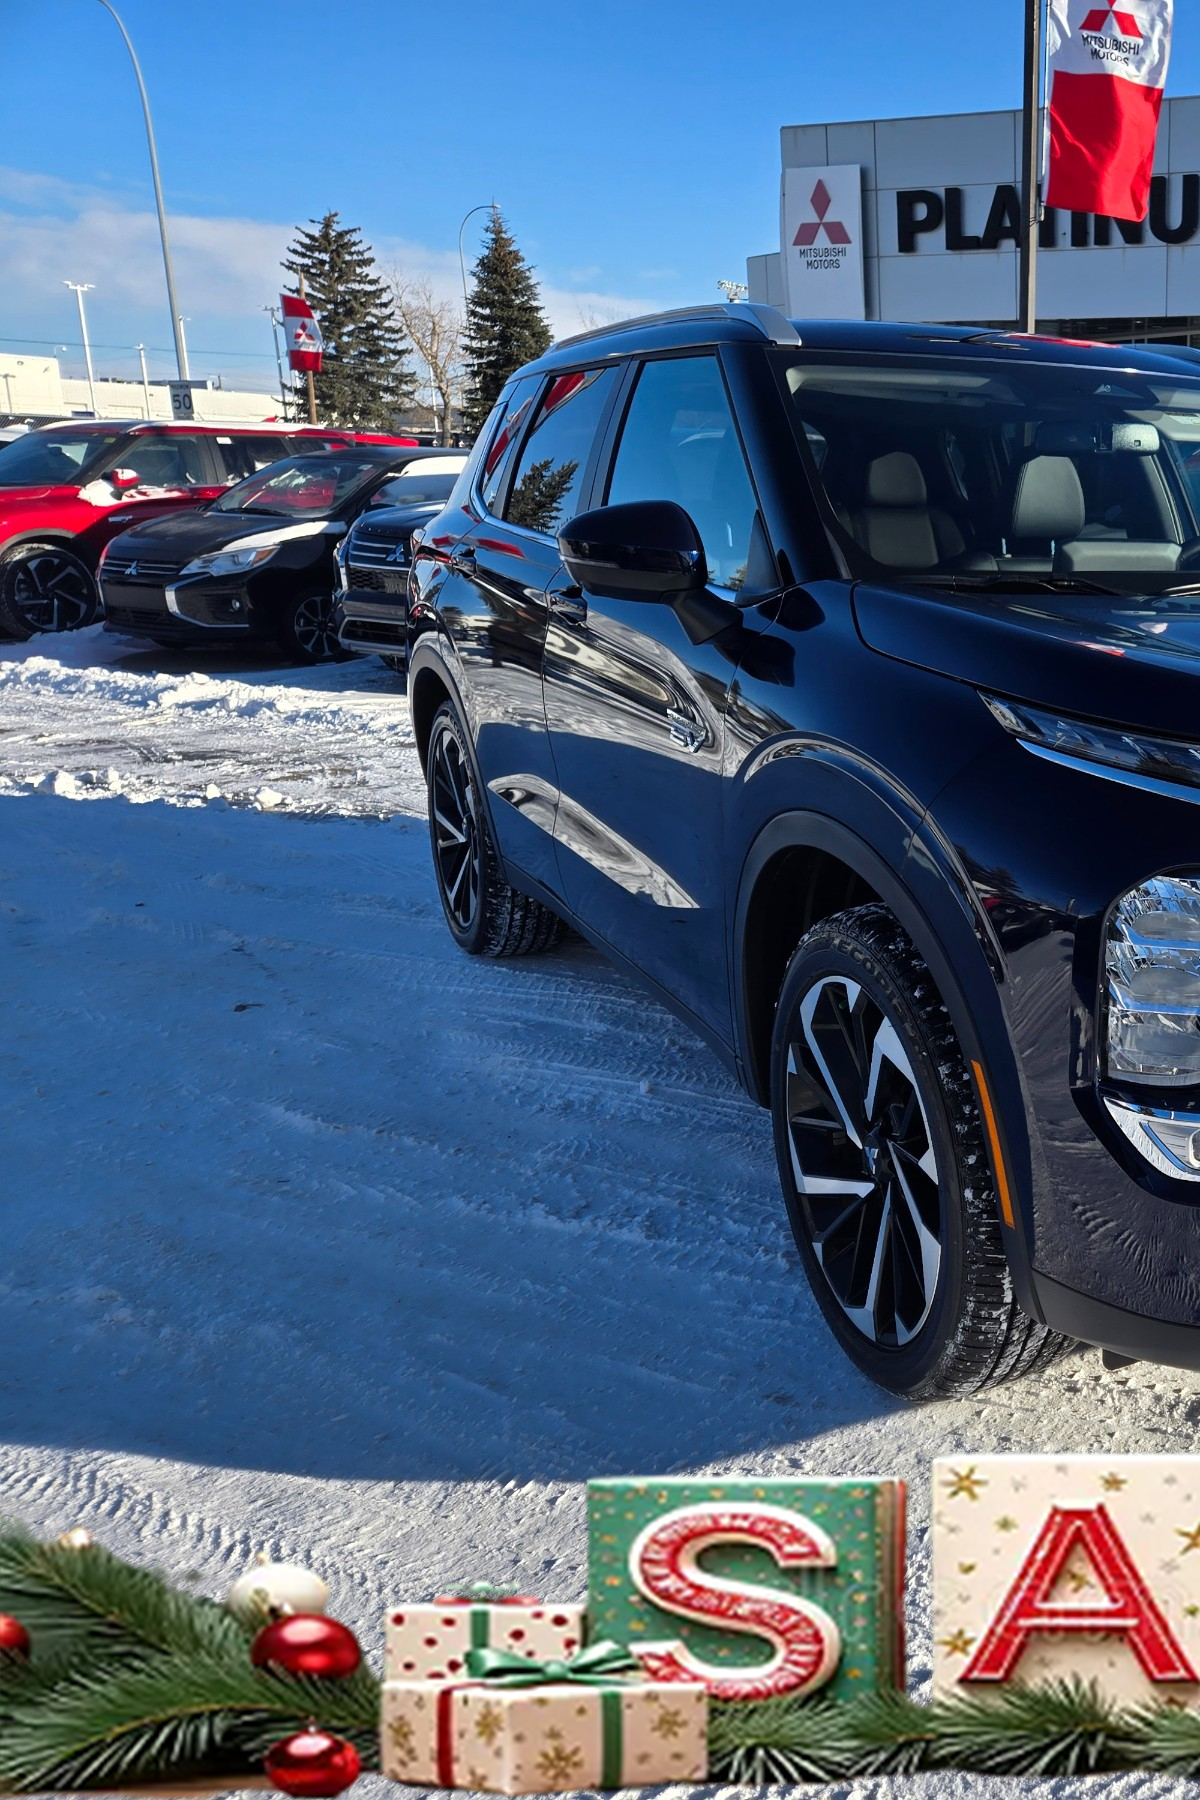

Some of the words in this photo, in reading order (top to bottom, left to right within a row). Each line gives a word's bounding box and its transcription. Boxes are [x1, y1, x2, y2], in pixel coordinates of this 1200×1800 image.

[1081, 34, 1140, 56] MITSUBISHI
[1090, 48, 1130, 67] MOTORS
[799, 247, 847, 259] MITSUBISHI
[806, 259, 841, 270] MOTORS
[172, 394, 193, 410] 50
